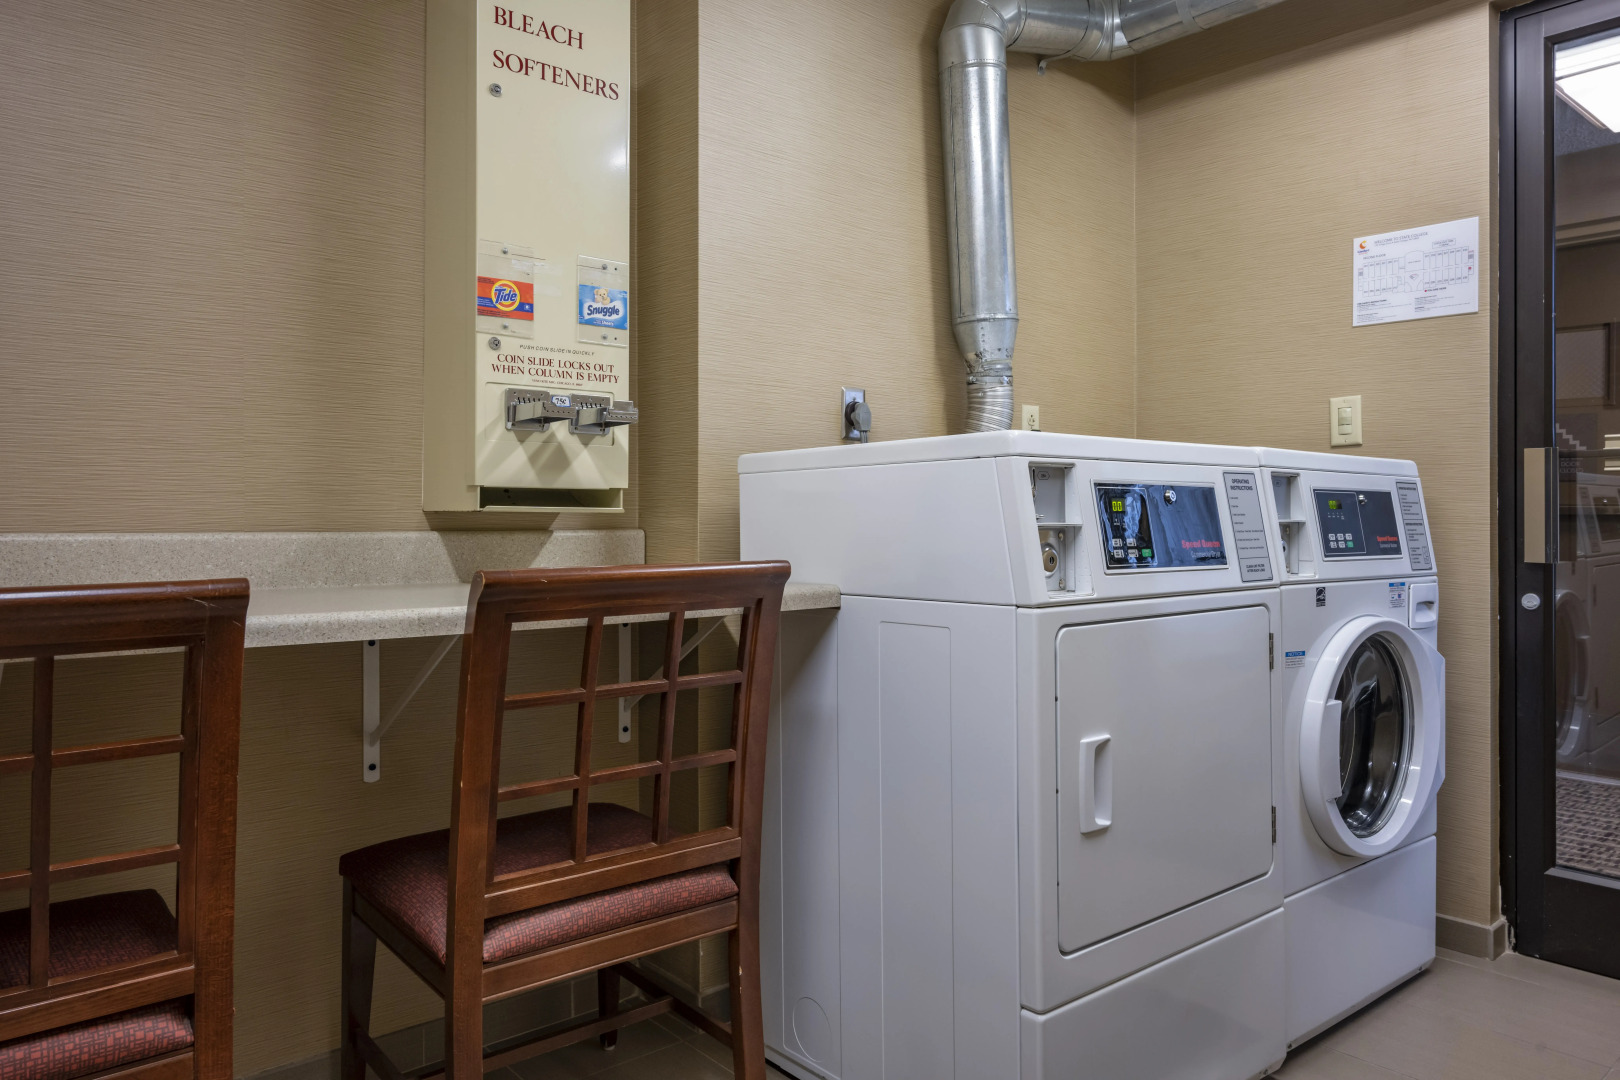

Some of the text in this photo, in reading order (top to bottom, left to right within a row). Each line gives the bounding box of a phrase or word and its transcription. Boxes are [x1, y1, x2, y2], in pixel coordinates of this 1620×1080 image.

[494, 5, 584, 50] BLEACH
[493, 49, 619, 101] SOFTENERS
[494, 288, 518, 304] Tide
[586, 304, 620, 317] Snuggle
[491, 363, 525, 375] WHEN
[528, 367, 573, 381] COLUMN
[576, 372, 585, 381] IS
[587, 372, 620, 384] EMPTY
[497, 353, 615, 374] COIN SLIDE LOCKS OUT
[1181, 539, 1221, 550] Speed Queen
